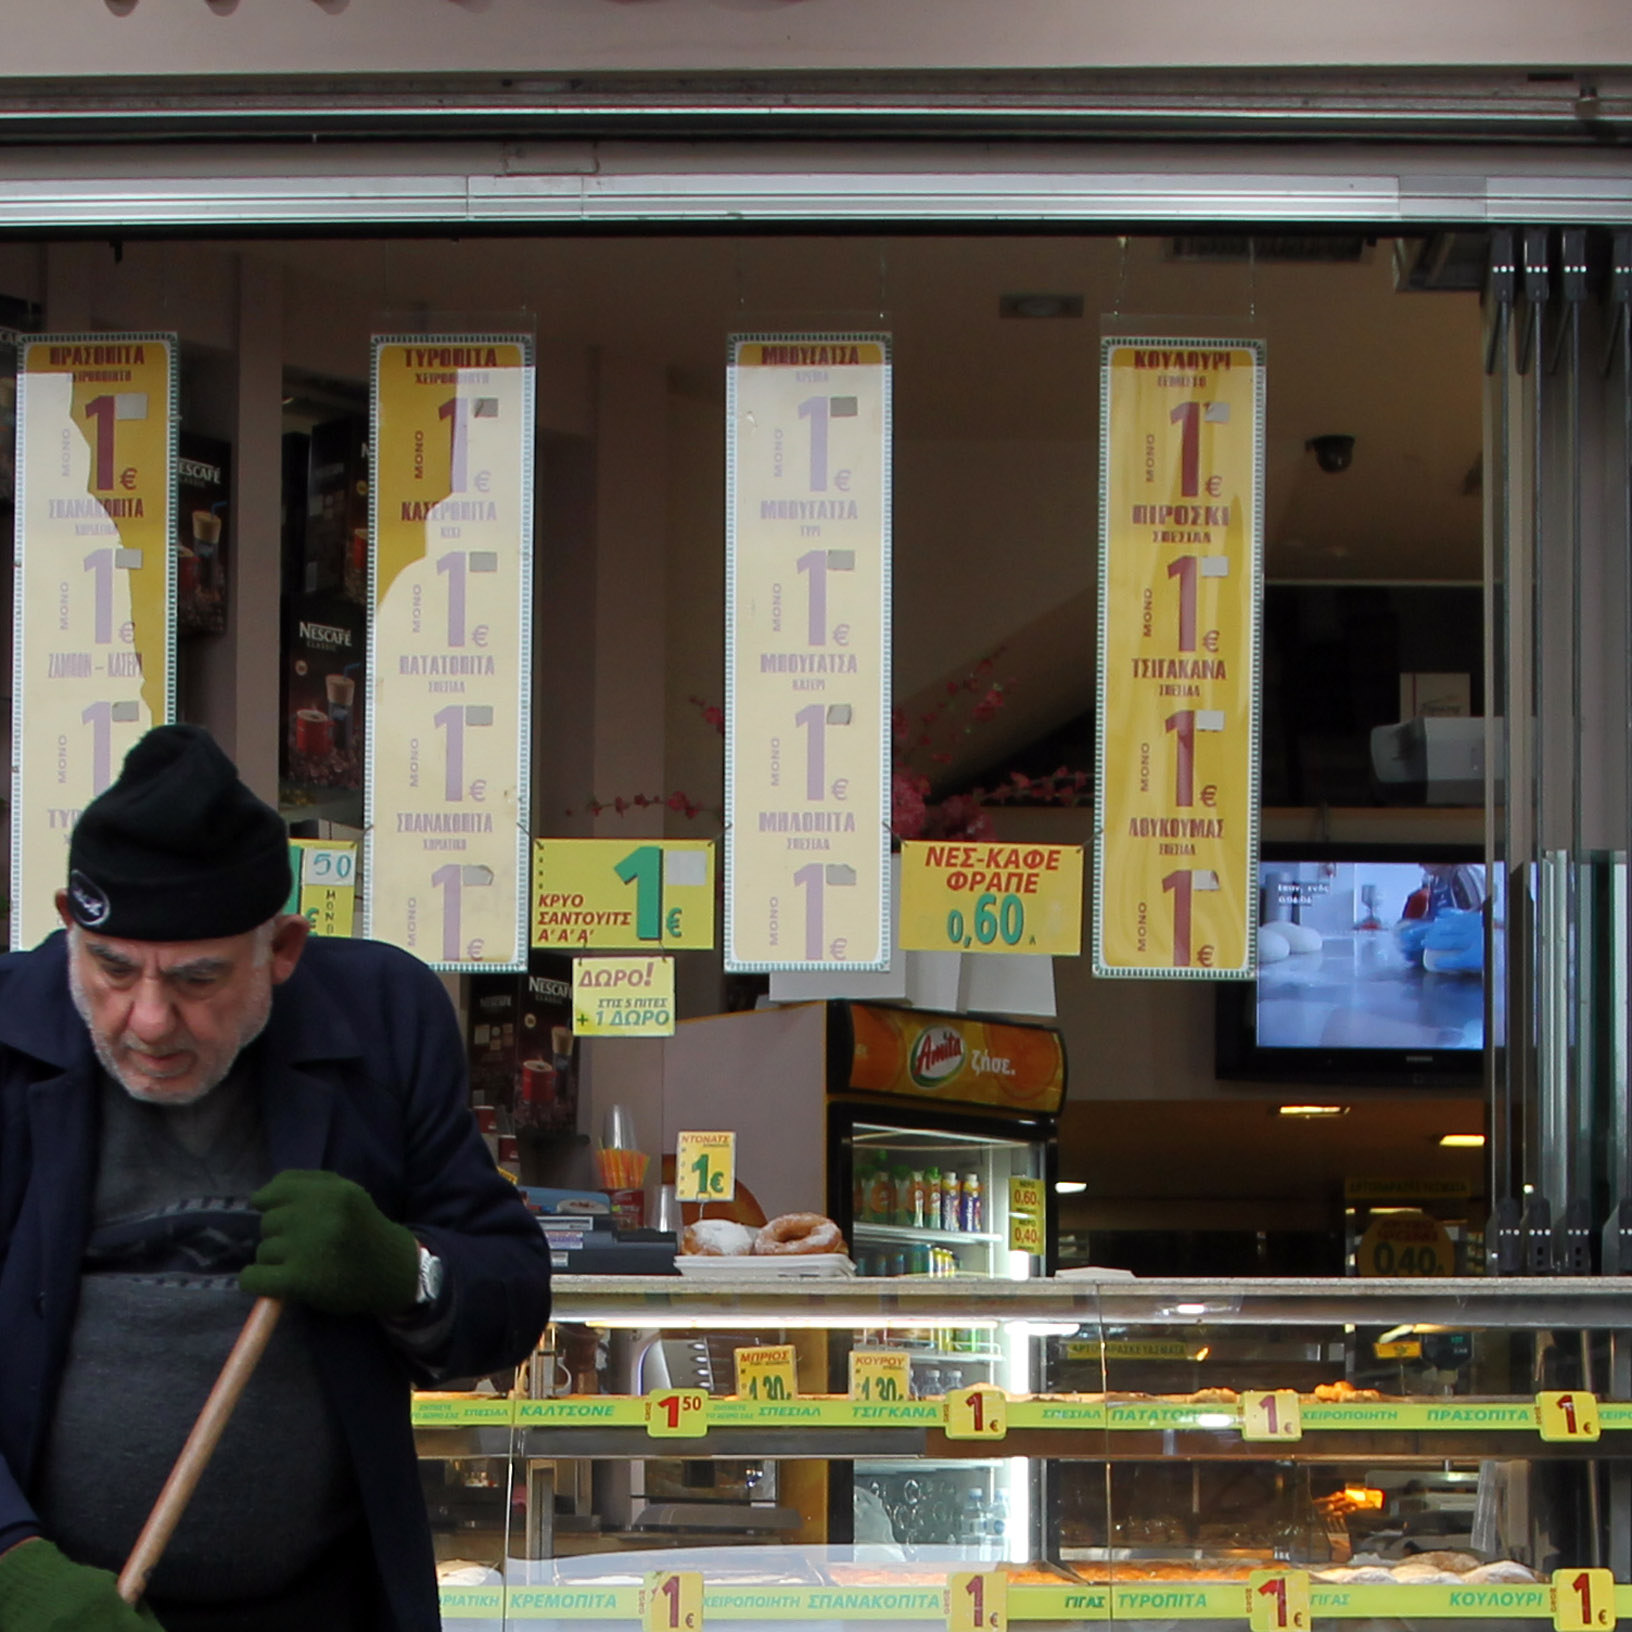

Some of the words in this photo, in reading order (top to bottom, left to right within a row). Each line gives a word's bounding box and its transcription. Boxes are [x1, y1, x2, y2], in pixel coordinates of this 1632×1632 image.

[50, 346, 144, 365] ΠΡΑΣΟΠΙΤΑ
[404, 348, 497, 367] ΤΥΡΟΠΙΤΑ
[762, 346, 859, 365] ΜΠΟΥΓΑΤΣΑ
[1134, 351, 1231, 370] ΚΟΥΛΟΥΡΙ
[179, 461, 221, 484] ESCAFÉ
[49, 498, 144, 518] ΣΠΑΝΑΚΟΠΙΤΑ
[401, 501, 497, 521] ΚΑΣΕΡΟΠΙΤΑ
[761, 500, 858, 520] ΜΠΟΥΓΑΤΣΑ
[1132, 505, 1230, 526] ΠΙΡΟΣΚΙ
[1143, 588, 1153, 637] ΜΟΝΟ
[299, 621, 352, 646] NESCAFÉ
[399, 655, 495, 675] ΠΑΤΑΤΟΠΙΤΑ
[760, 654, 858, 673] ΜΠΟΥΓΑΤΣΑ
[1141, 742, 1149, 792] ΜΟΝΟ
[397, 813, 493, 833] ΣΠΑΝΑΚΟΠΙΤΑ
[758, 812, 856, 832] ΜΗΛΟΠΙΤΑ
[1129, 818, 1225, 839] ΛΟΥΚΟΥΜΑΣ
[314, 853, 352, 878] 50
[925, 846, 1061, 871] ΝΕΣ-ΚΑΦΕ
[946, 871, 1040, 894] ΦΡΑΠΕ
[538, 894, 584, 908] ΚΡΥΟ
[538, 911, 632, 926] ΣΑΝΤΟΥΙΤΣ
[947, 893, 1024, 948] 0,60
[1138, 902, 1147, 952] ΜΟΝΟ
[578, 962, 654, 987] ΔΩΡΟ!
[529, 976, 574, 999] NESCAF
[598, 998, 622, 1008] ΣΤΙΣ
[625, 998, 631, 1008] 5
[634, 998, 668, 1008] ΠΙΤΕΣ
[596, 1010, 605, 1026] 1
[609, 1010, 670, 1026] ΔΩΡΟ
[914, 1032, 962, 1076] Amita
[855, 1356, 905, 1366] ΚΟΥΡΟΥ
[520, 1405, 614, 1417] ΚΑΛΤΣΟΝΕ
[758, 1406, 822, 1417] ΣΠΕΣΙΑΛ
[852, 1406, 937, 1418] ΤΣΙΓΚΑΝΑ
[1041, 1409, 1101, 1419] ΣΠΕΣΙΑΛ
[1427, 1409, 1529, 1421] ΠΡΑΣΟΠΙΤΑ
[510, 1594, 617, 1608] ΚΡΕΜΟΠΙΤΑ
[807, 1594, 939, 1609] ΣΠΑΝΑΚΟΠΙΤΑ
[1064, 1596, 1105, 1609] ΓΙΓΑΣ
[1119, 1594, 1207, 1609] ΤΥΡΟΠΙΤΑ
[1311, 1594, 1351, 1606] ΓΙΓΑΣ
[1450, 1592, 1543, 1607] ΚΟΥΛΟΥΡΙ
